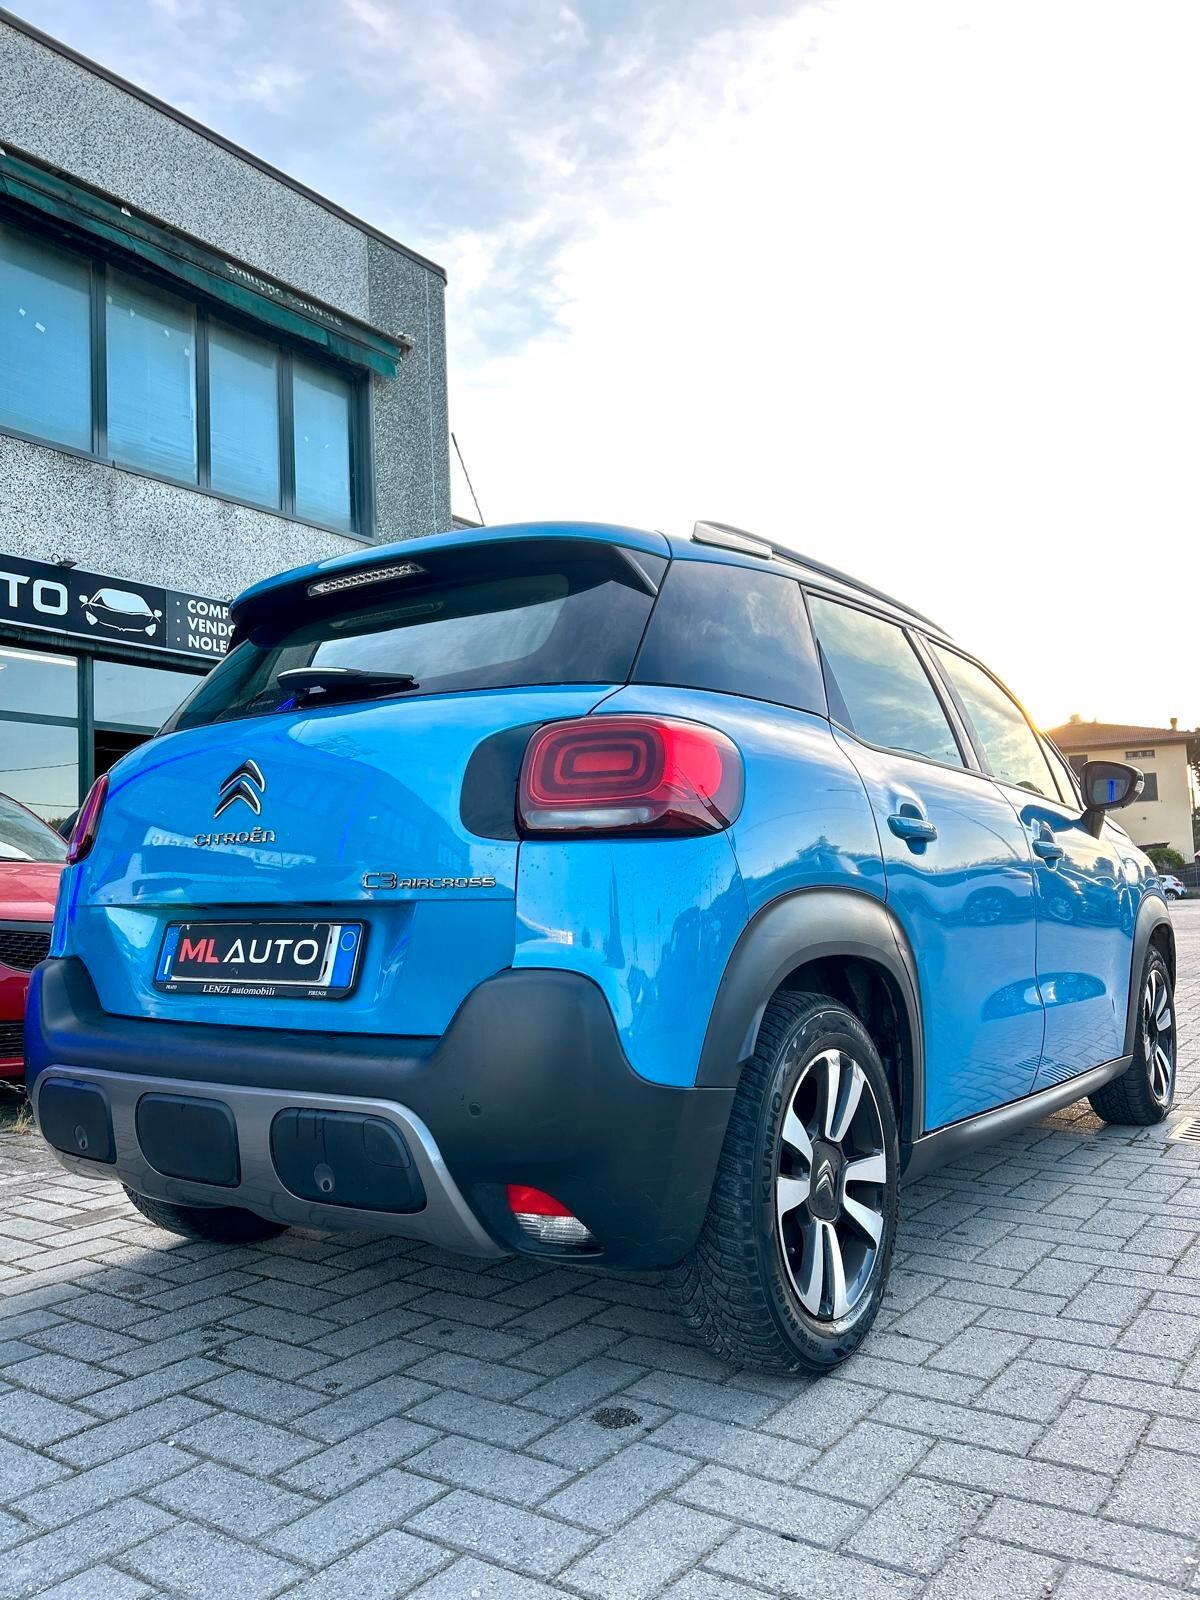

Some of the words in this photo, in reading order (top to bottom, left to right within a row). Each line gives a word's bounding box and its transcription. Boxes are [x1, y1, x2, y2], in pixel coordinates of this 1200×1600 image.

[188, 634, 230, 653] NOLE
[362, 871, 398, 889] C3
[399, 876, 497, 889] AIRCROSS
[222, 938, 319, 965] AUTO
[202, 984, 230, 994] LENZI
[231, 986, 276, 996] automobili
[762, 1091, 783, 1204] KUMHO
